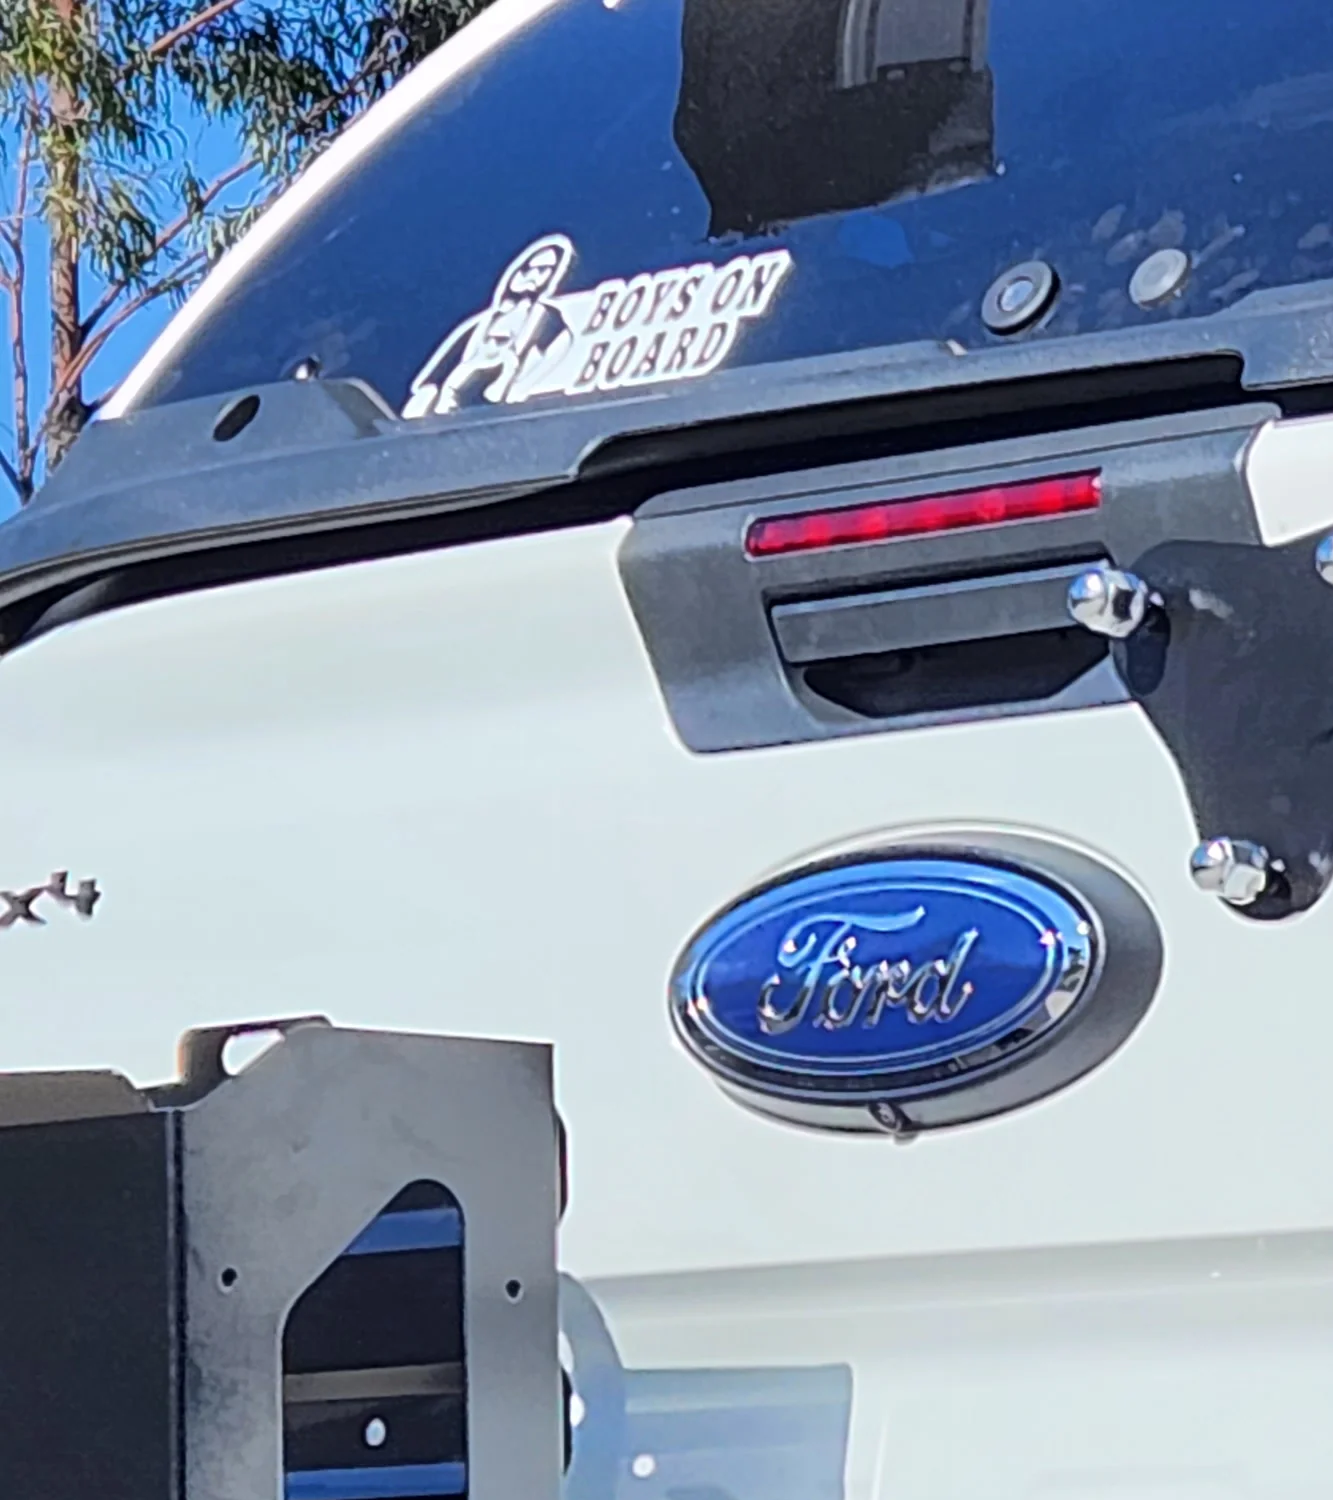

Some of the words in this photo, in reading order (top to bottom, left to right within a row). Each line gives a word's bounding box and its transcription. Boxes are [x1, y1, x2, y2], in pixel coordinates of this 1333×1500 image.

[583, 274, 703, 335] BOYS
[710, 262, 780, 312] ON
[574, 320, 731, 387] BOARD
[758, 906, 980, 1035] Ford
